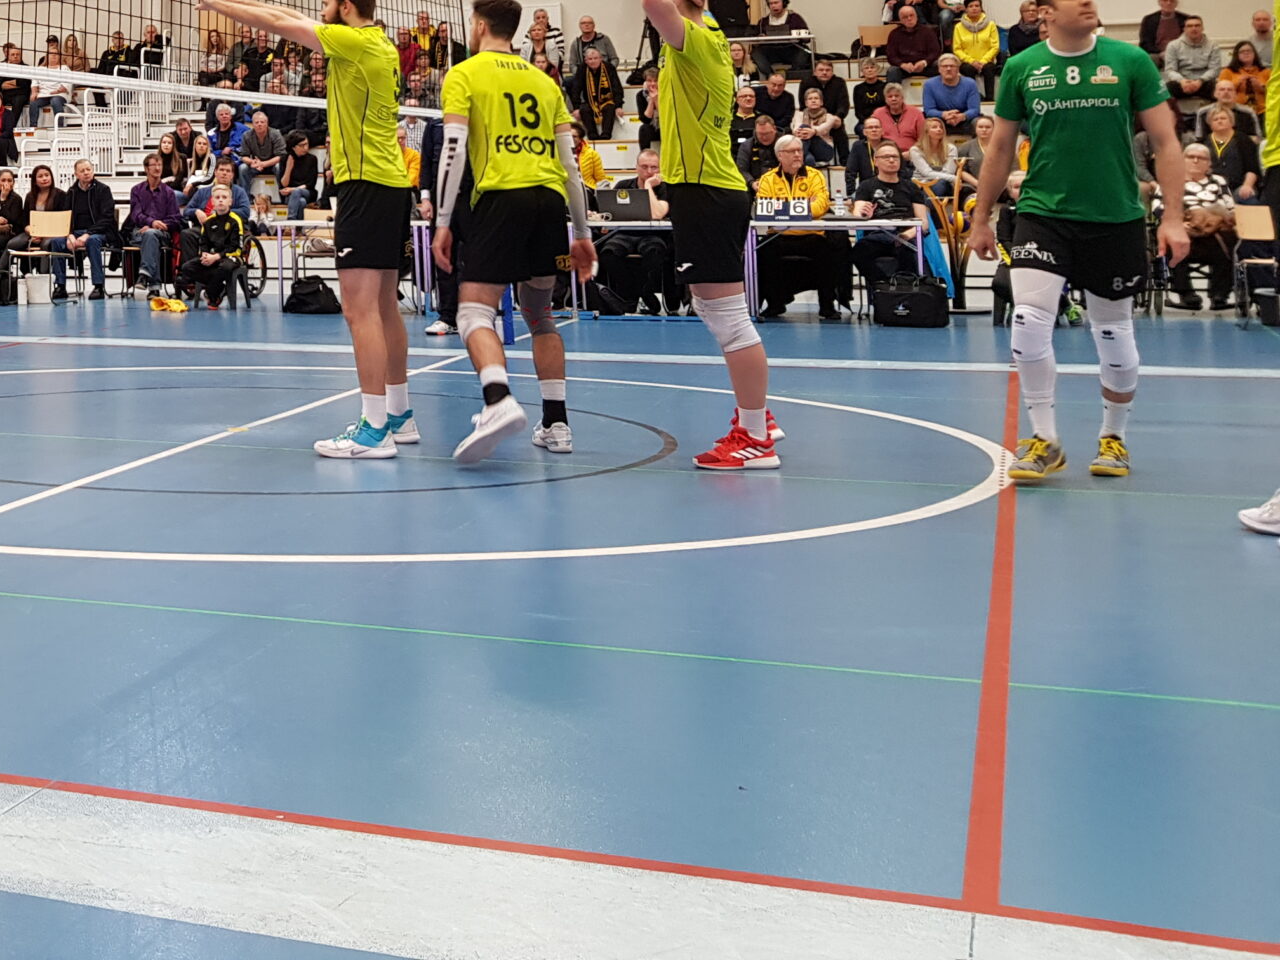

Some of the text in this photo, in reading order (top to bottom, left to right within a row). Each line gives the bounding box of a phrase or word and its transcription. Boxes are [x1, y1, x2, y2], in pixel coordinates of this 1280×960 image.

[494, 59, 529, 71] TAYLOR
[1066, 65, 1081, 85] 8
[1028, 77, 1057, 88] RUUTU
[503, 92, 541, 130] 13
[1048, 98, 1120, 111] LÄHITAPIOLA
[759, 200, 773, 214] 10
[793, 201, 806, 214] 6
[1112, 277, 1123, 292] 8
